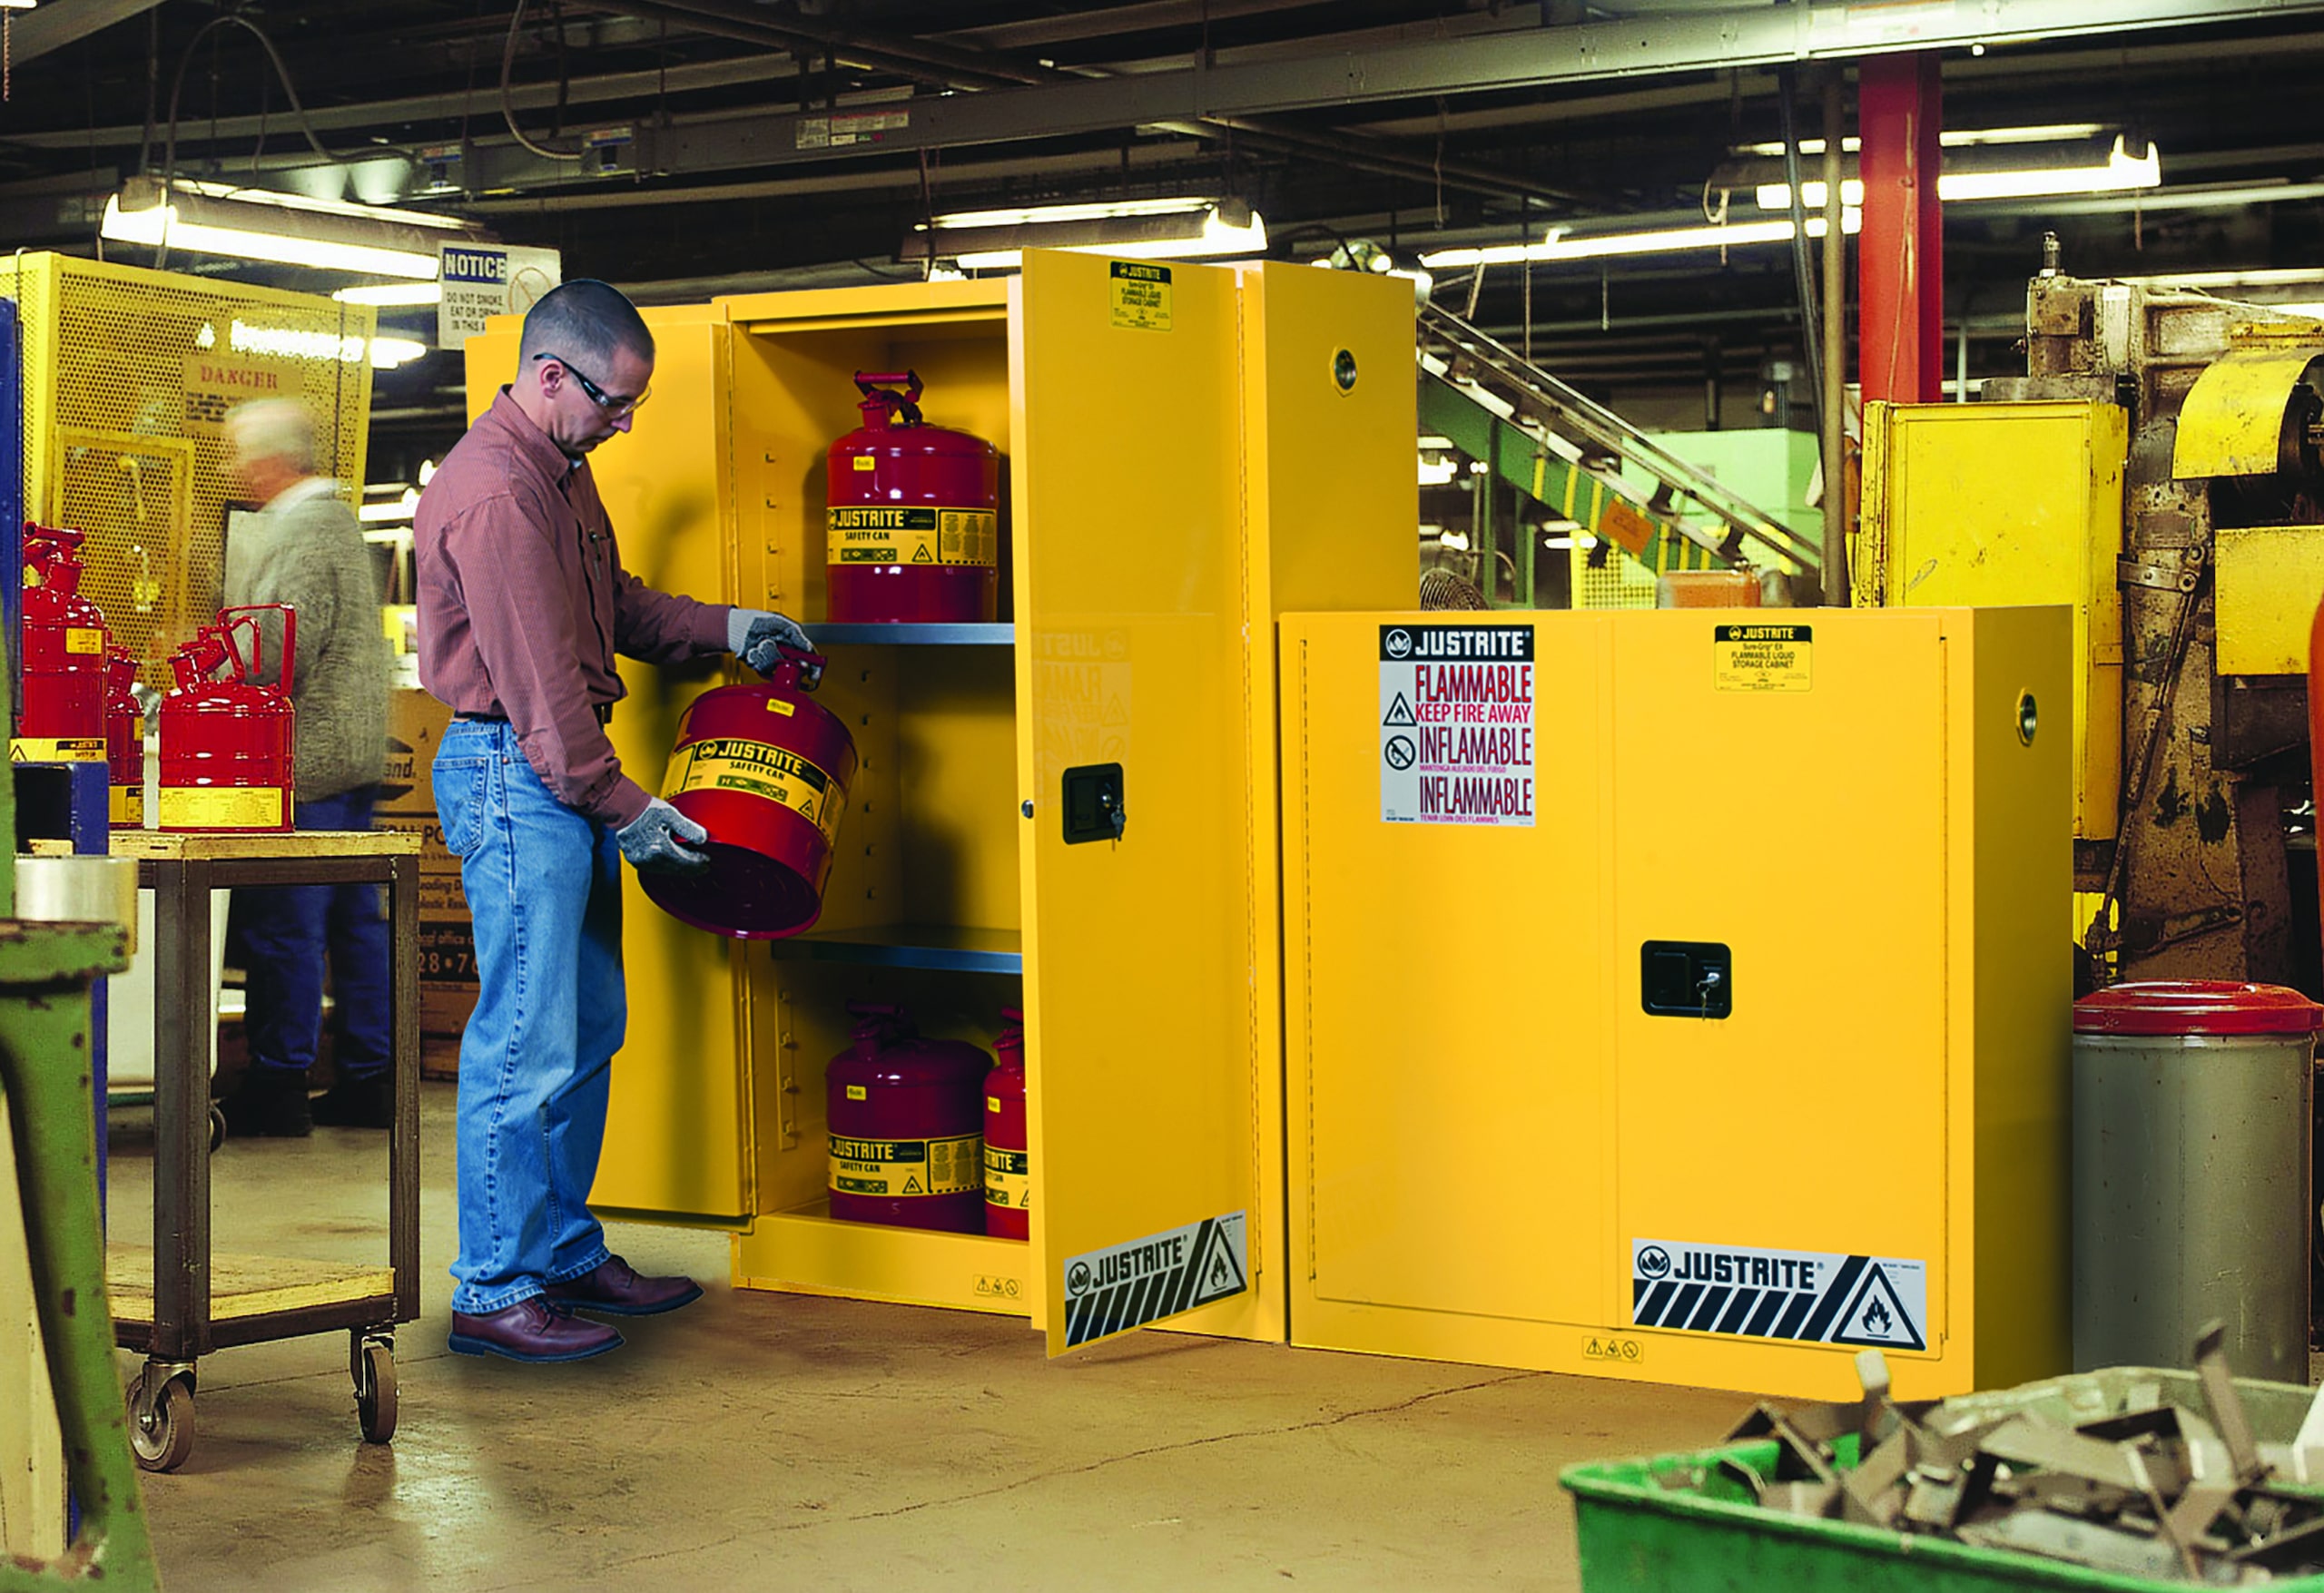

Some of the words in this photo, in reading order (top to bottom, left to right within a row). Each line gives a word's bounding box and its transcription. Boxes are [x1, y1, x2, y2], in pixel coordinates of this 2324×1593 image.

[445, 253, 507, 280] NOTICE
[201, 365, 278, 389] DANGER
[845, 531, 871, 542] SAFETY
[872, 531, 891, 542] CAN
[1415, 664, 1532, 703] FLAMMABLE
[1415, 703, 1452, 723] KEEP
[1454, 704, 1485, 723] FIRE
[1488, 704, 1532, 724] AWAY
[1419, 726, 1532, 765] INFLAMABLE
[729, 760, 765, 775] SAFETY
[765, 768, 786, 782] CAN
[1419, 776, 1532, 816] INFLAMMABLE
[840, 1160, 862, 1172] SAFETY
[863, 1163, 881, 1173] CAN
